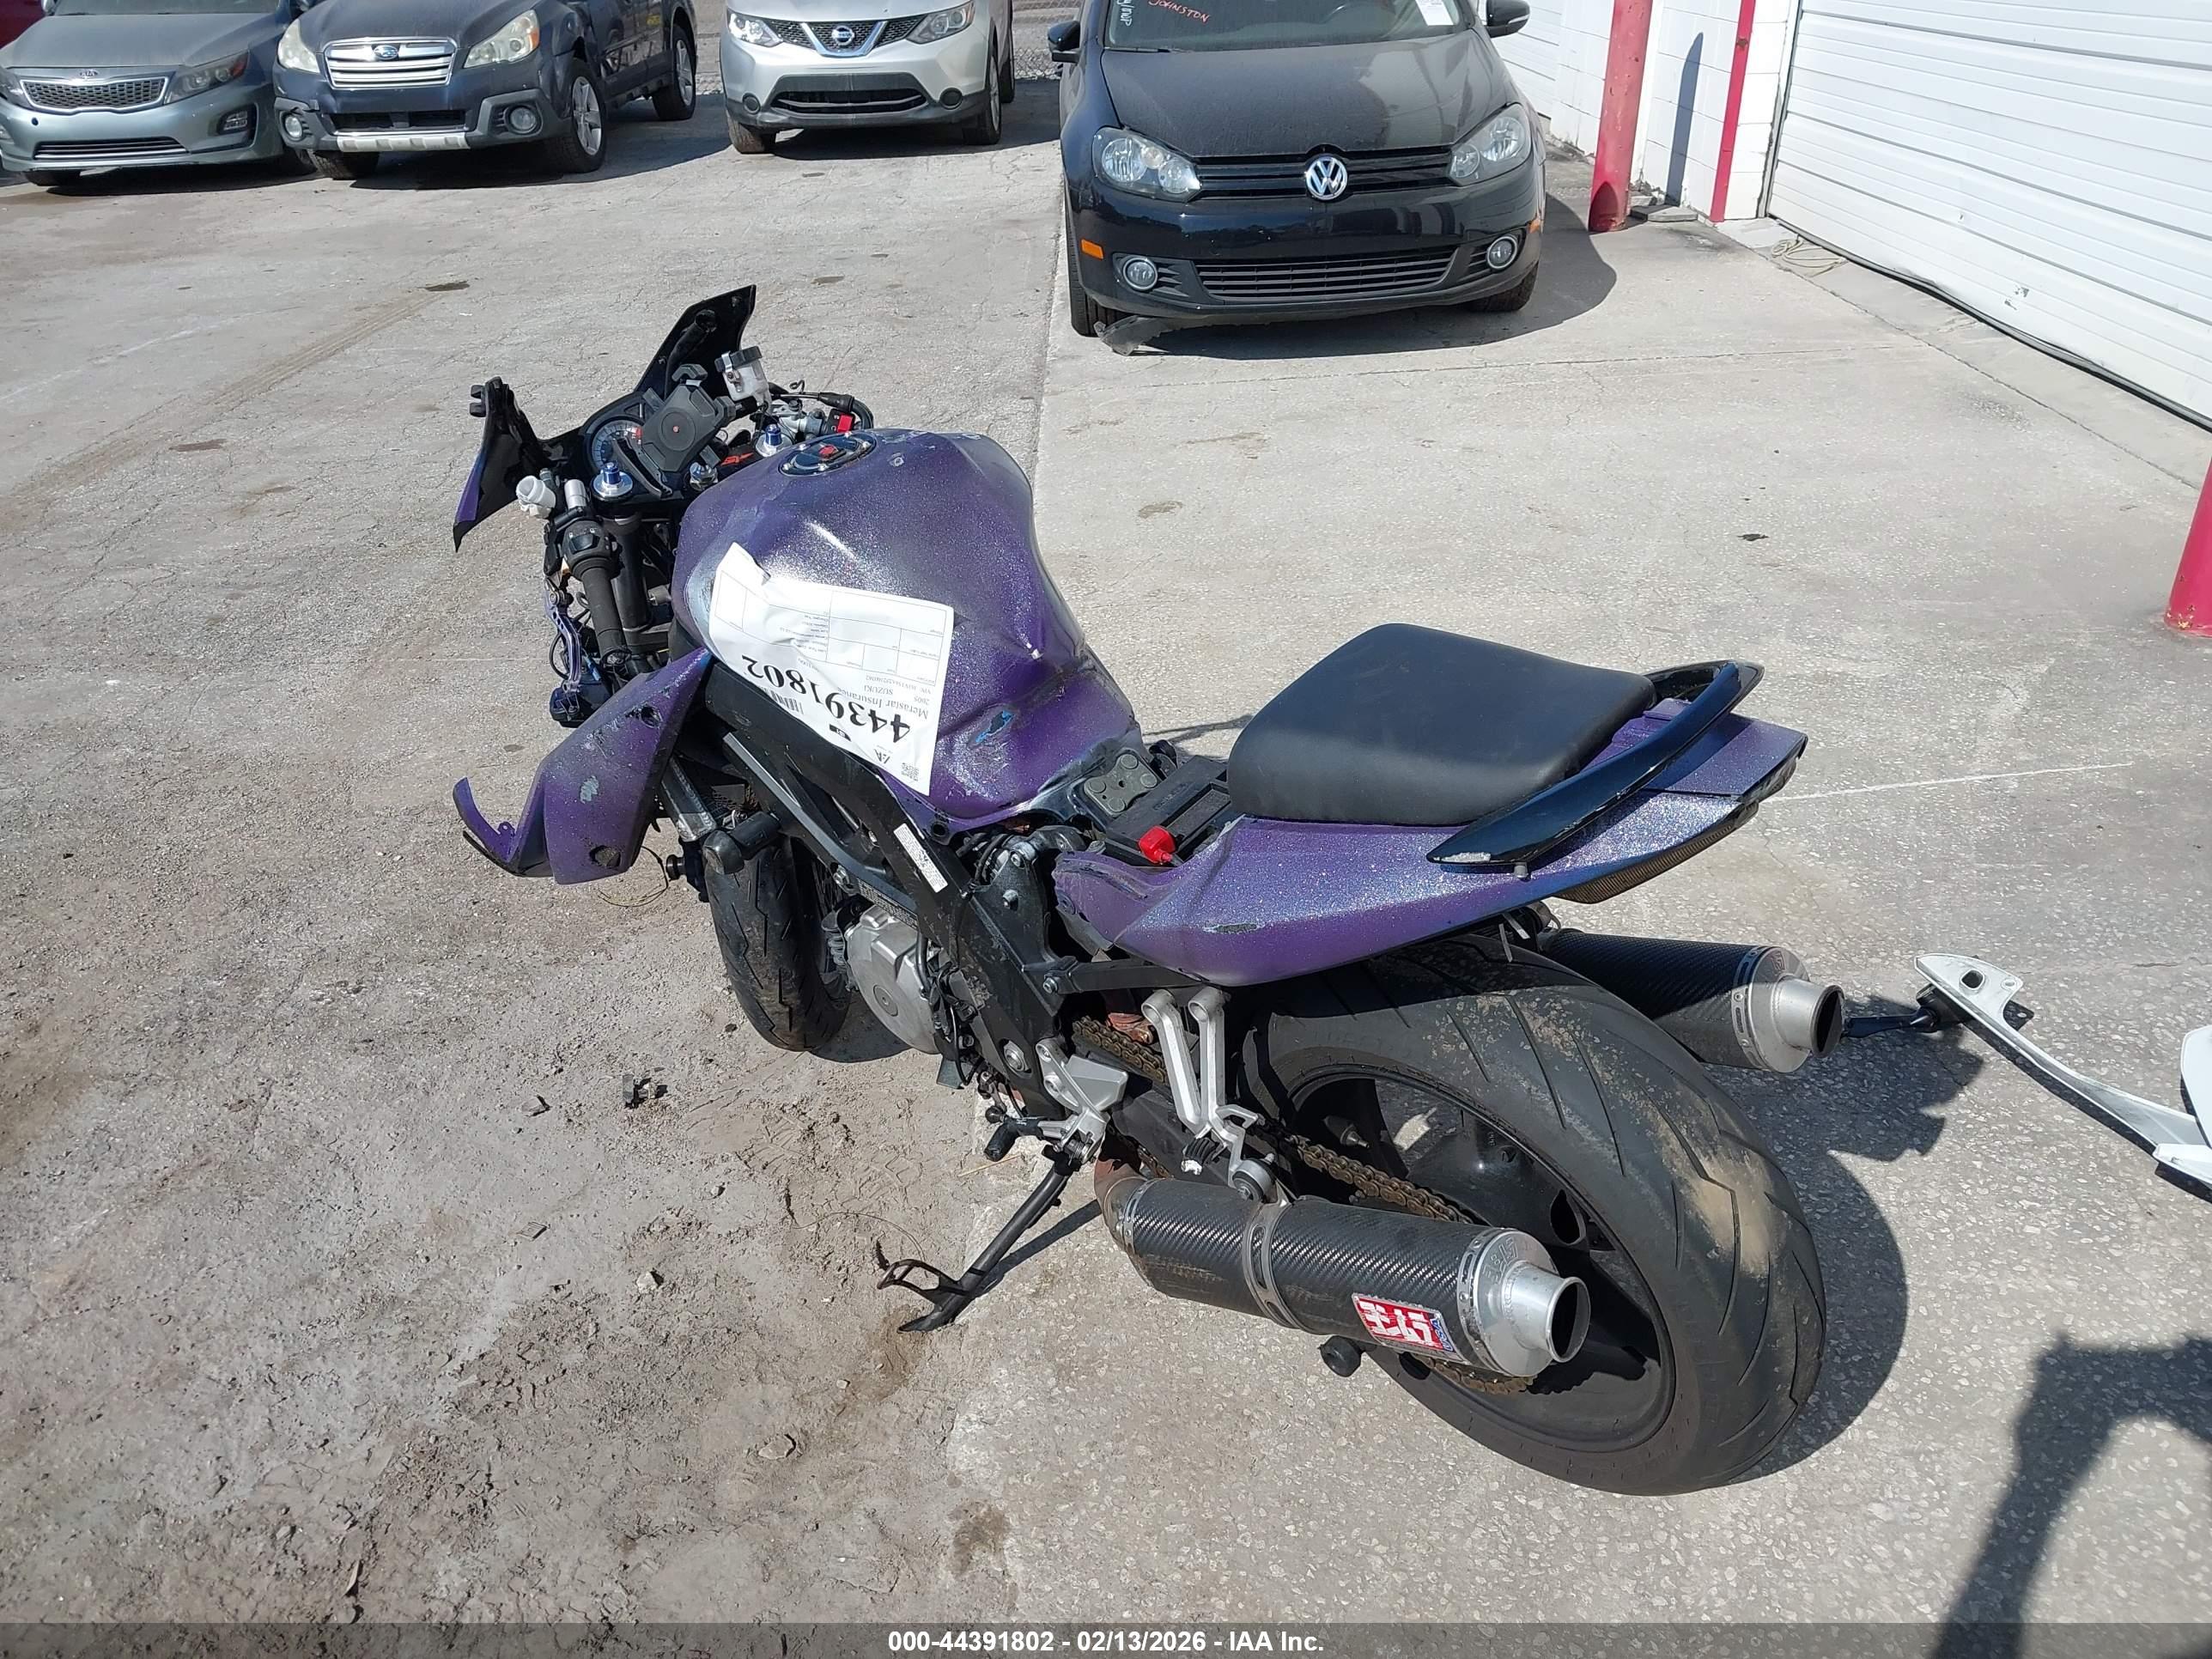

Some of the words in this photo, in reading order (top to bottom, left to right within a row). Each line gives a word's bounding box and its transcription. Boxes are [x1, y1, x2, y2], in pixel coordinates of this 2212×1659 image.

[1148, 0, 1211, 23] JOHNSTON
[741, 654, 911, 743] 44391802
[837, 687, 883, 708] Insurance
[864, 684, 893, 695] SUZUKI
[885, 700, 928, 720] Merastar
[1431, 1317, 1455, 1352] USA
